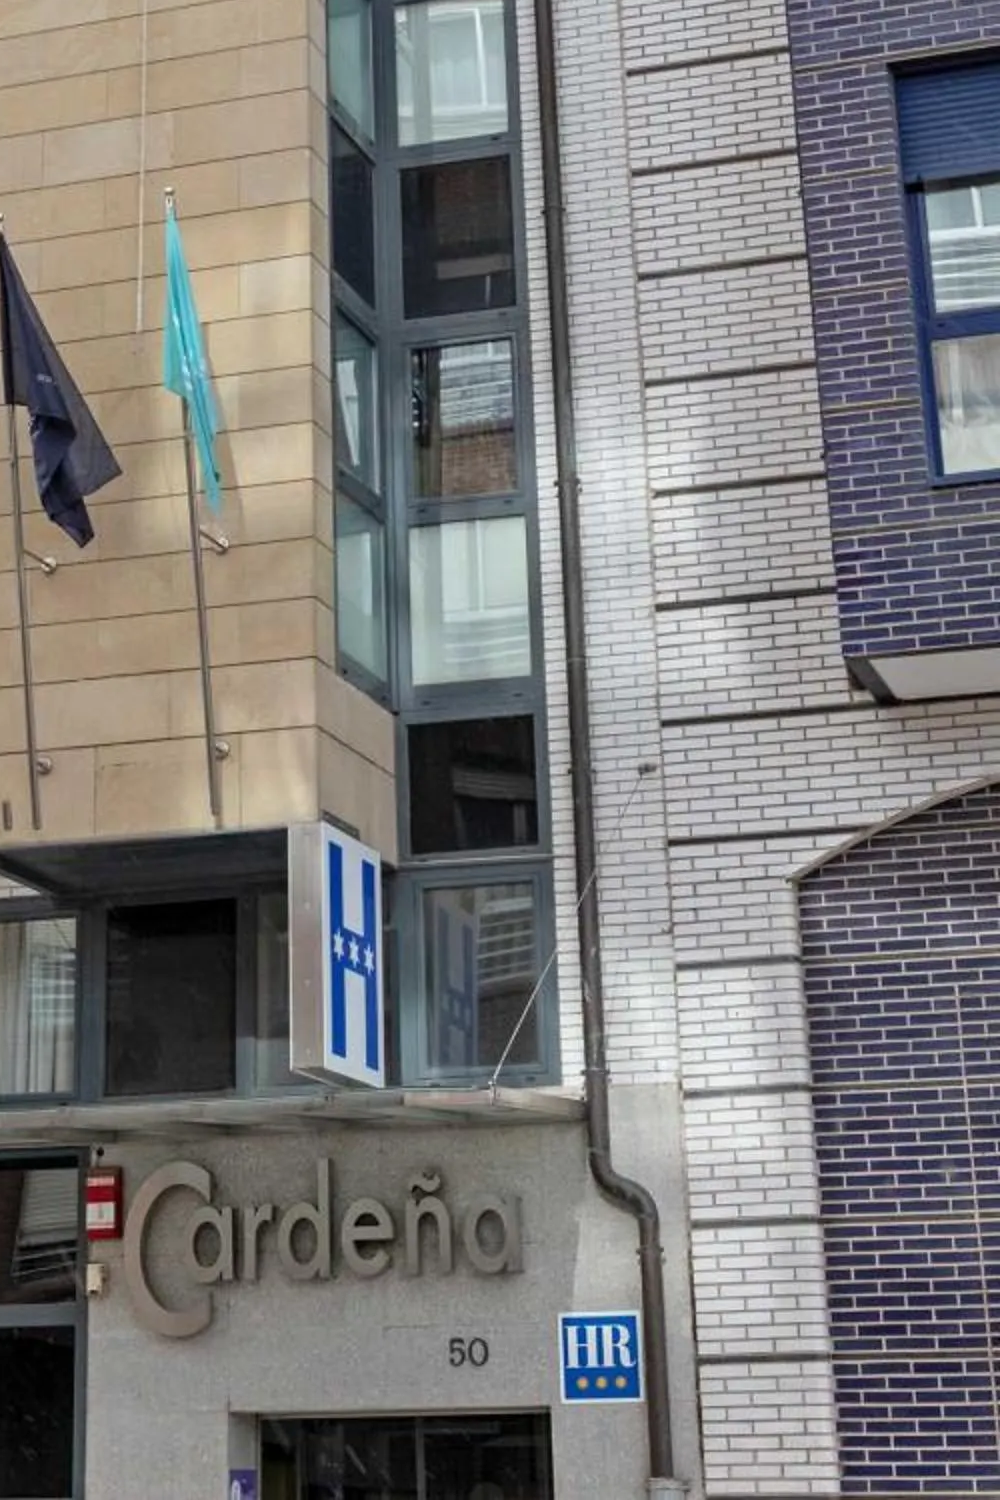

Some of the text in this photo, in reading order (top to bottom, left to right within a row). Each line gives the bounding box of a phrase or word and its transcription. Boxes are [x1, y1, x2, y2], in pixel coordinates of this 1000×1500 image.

[329, 841, 379, 1070] H
[124, 1158, 523, 1338] Cardeña
[448, 1337, 490, 1367] 50
[564, 1324, 637, 1369] HR
